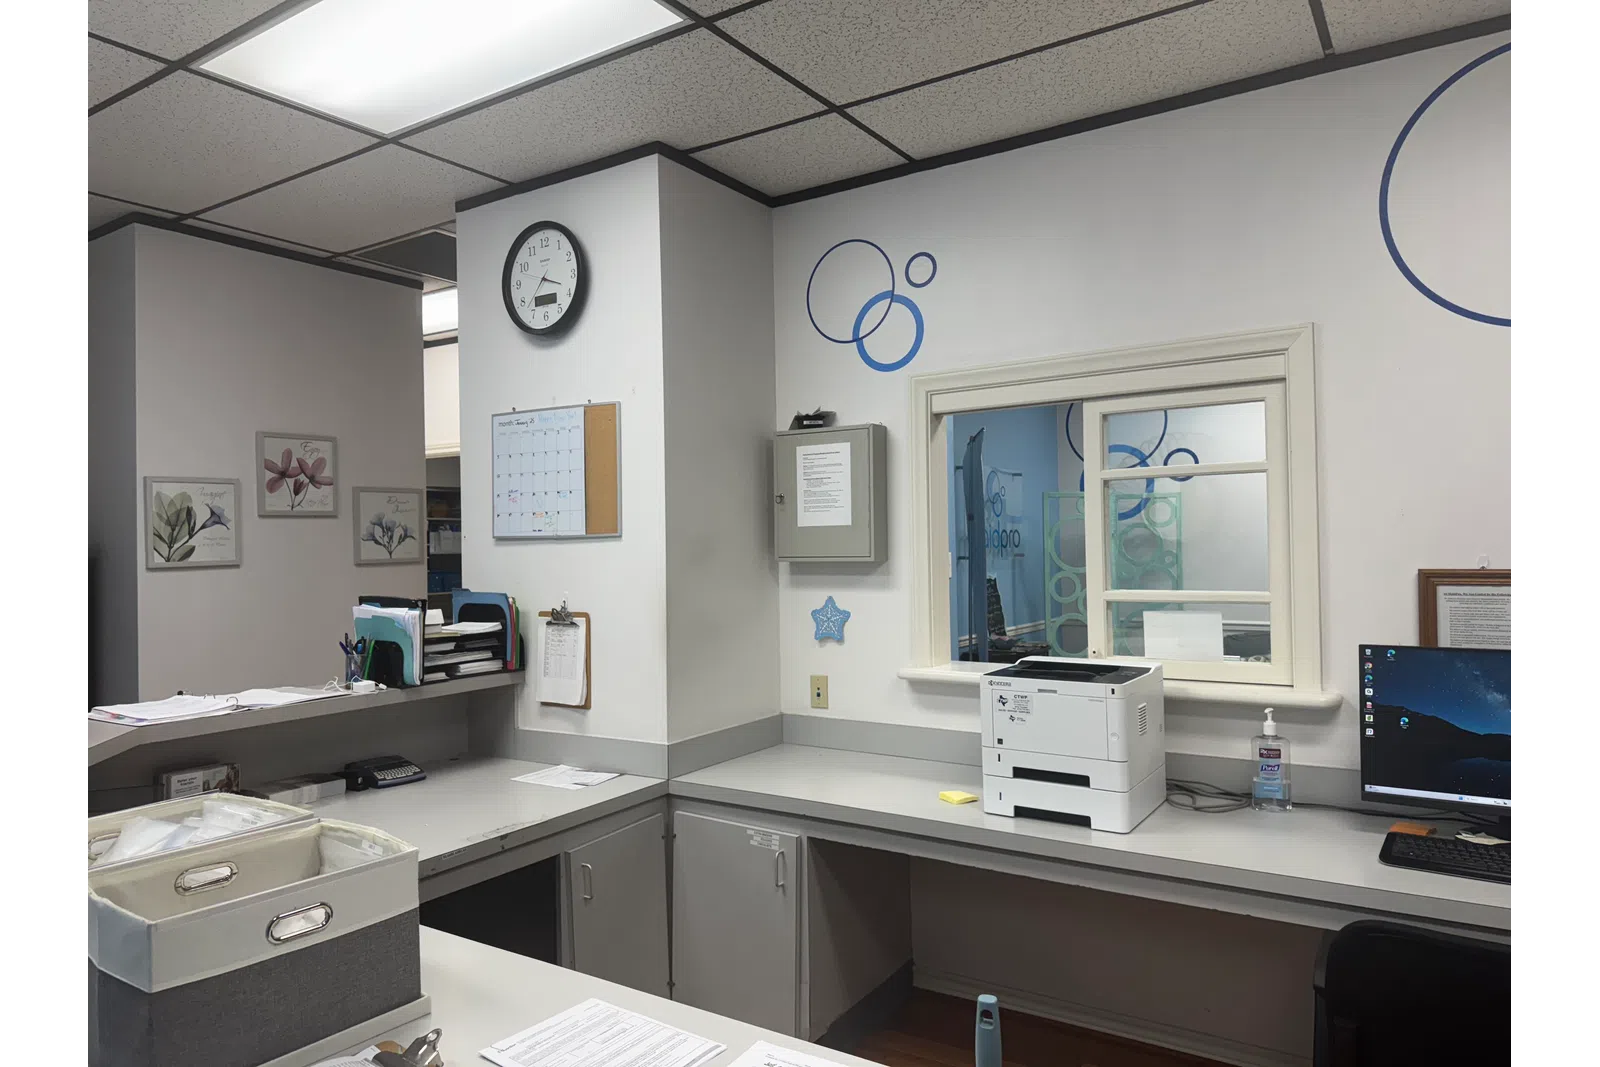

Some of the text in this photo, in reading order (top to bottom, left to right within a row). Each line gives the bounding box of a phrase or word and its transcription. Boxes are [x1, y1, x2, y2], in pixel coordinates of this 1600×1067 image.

[540, 237, 550, 248] 12
[557, 240, 561, 250] 1
[528, 246, 536, 256] 11
[566, 251, 572, 262] 2
[520, 262, 529, 272] 10
[570, 268, 576, 279] 3
[516, 280, 522, 290] 9
[566, 288, 572, 298] 4
[520, 296, 526, 306] 8
[531, 308, 536, 319] 7
[558, 304, 562, 314] 5
[544, 311, 549, 321] 6
